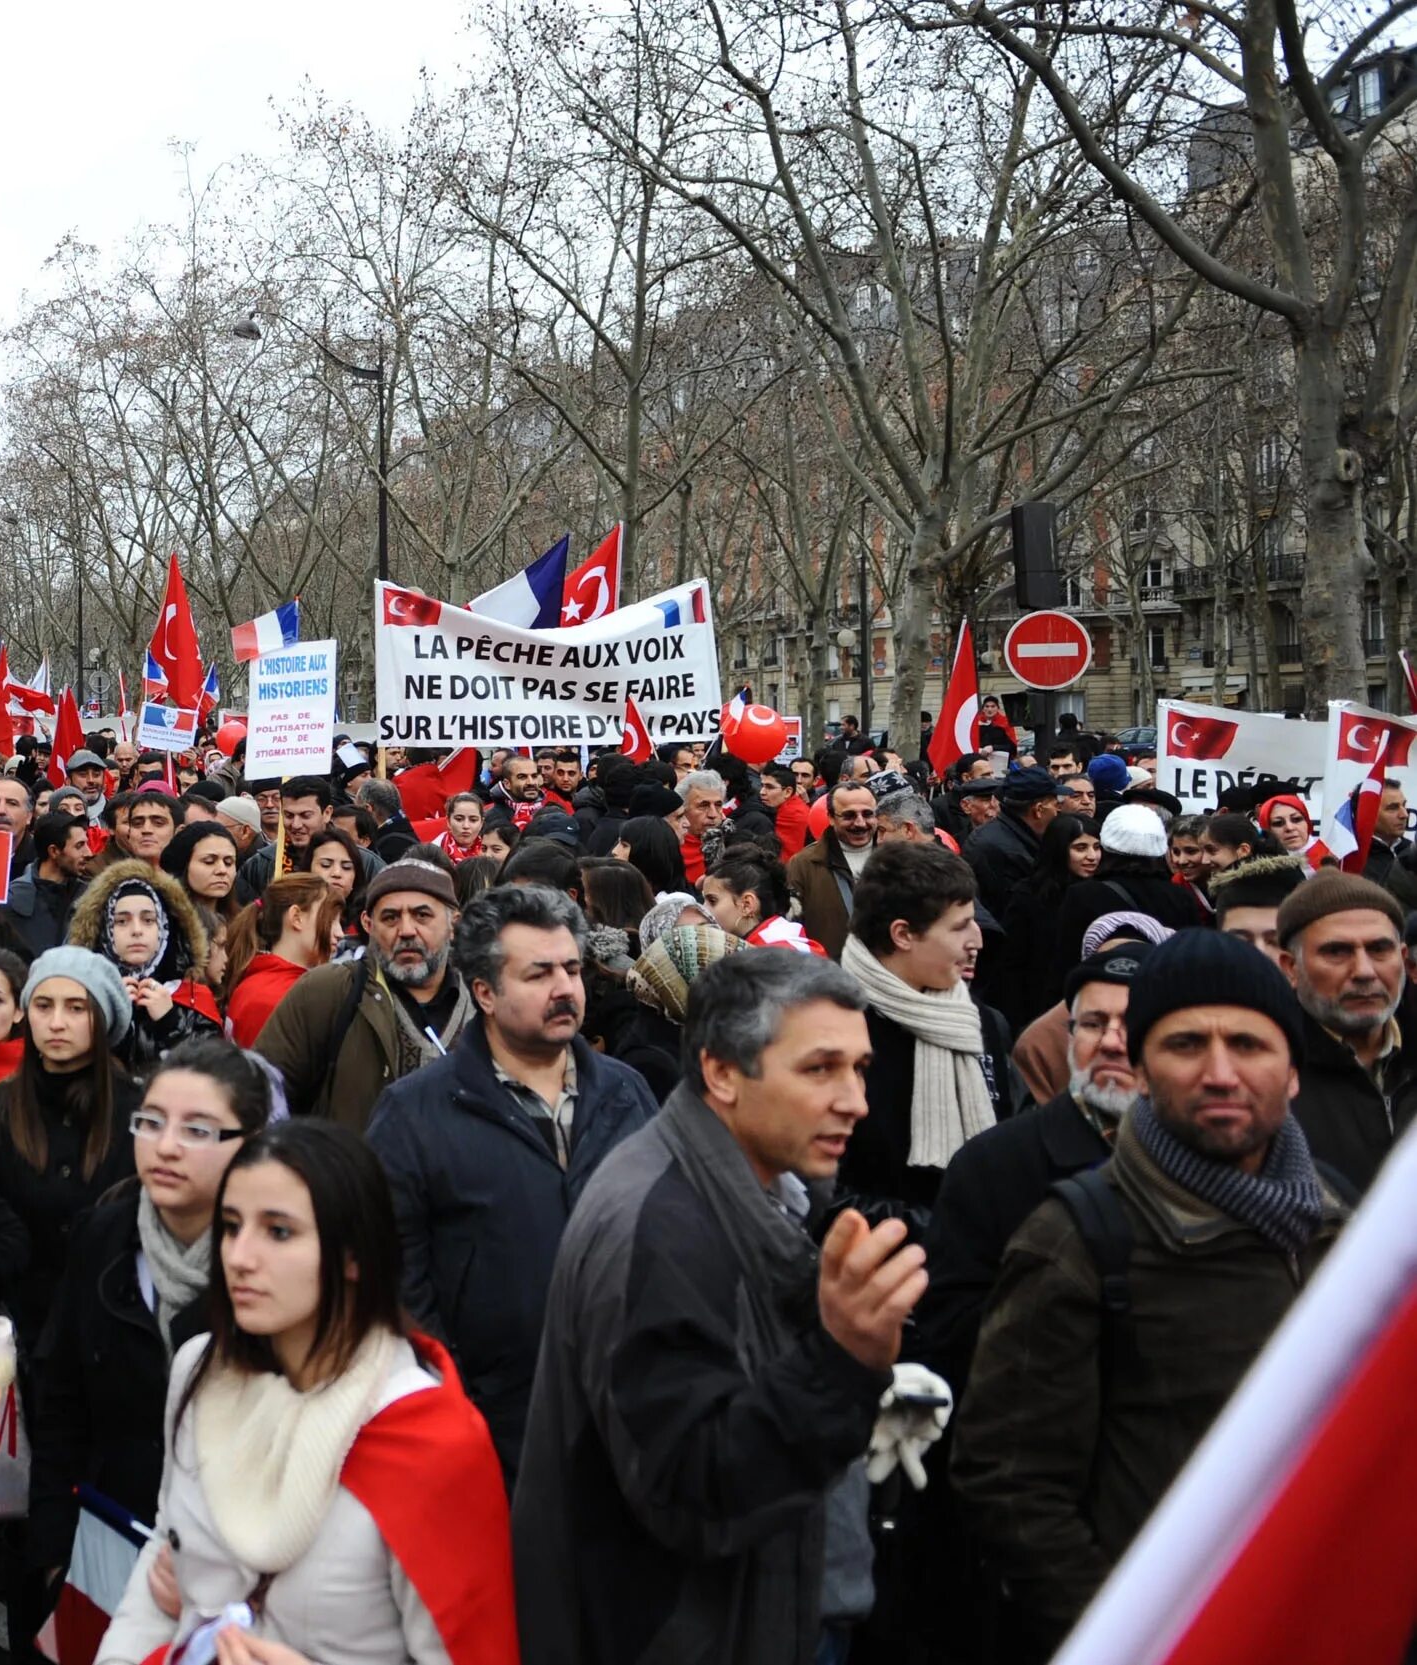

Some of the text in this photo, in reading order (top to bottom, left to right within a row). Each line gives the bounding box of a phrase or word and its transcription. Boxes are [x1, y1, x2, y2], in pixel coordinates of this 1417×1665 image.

[414, 634, 685, 668] LA PÊCHE AUX VOIX
[259, 654, 327, 676] L'HISTOIRE AUX
[258, 678, 328, 701] HISTORIENS
[405, 673, 695, 703] NE DOIT PAS SE FAIRE
[270, 712, 311, 721] PAS DE
[380, 715, 432, 741] SUR
[438, 714, 583, 741] L’HISTOIRE
[660, 708, 721, 738] PAYS
[255, 722, 325, 734] POLITISATION
[272, 733, 309, 744] PAS DE
[255, 746, 325, 759] STIGMATISATION
[1175, 766, 1324, 800] LE DÉT
